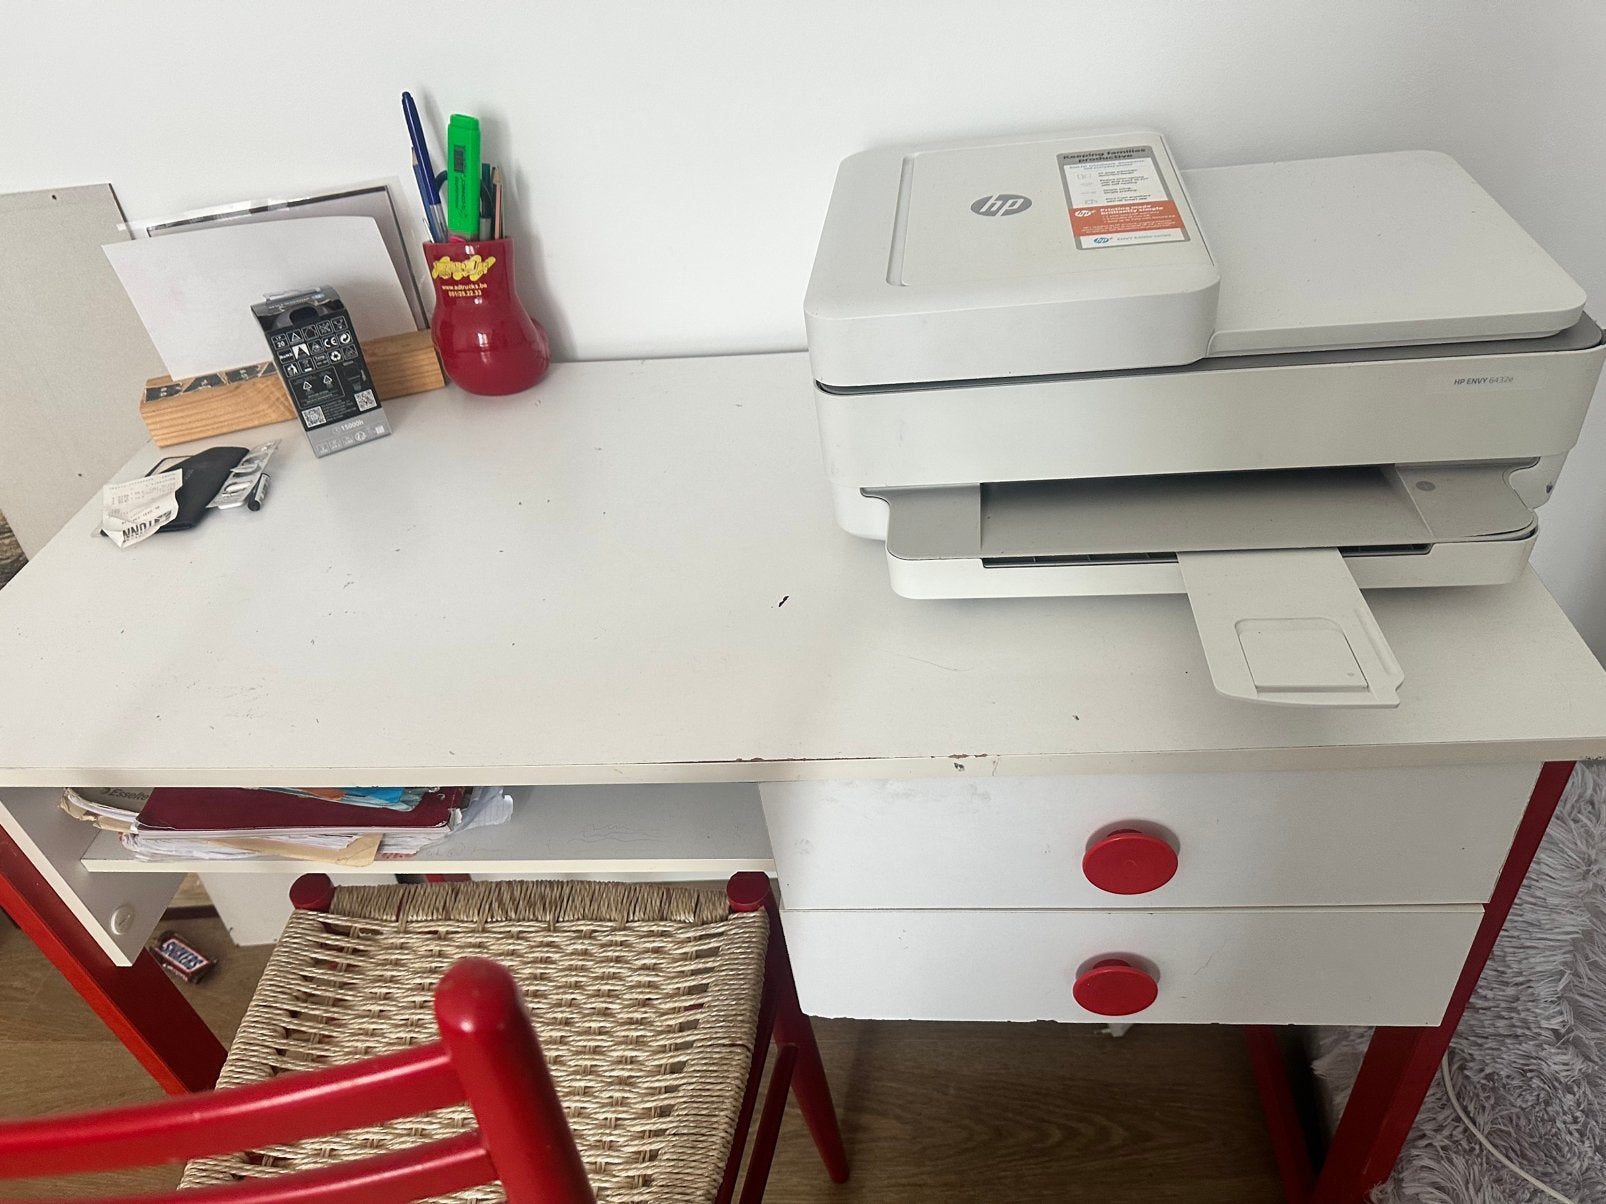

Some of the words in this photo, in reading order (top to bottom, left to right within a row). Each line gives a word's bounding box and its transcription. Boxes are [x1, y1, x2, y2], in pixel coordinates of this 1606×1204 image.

[1063, 151, 1104, 160] Keeping
[1107, 148, 1146, 156] families
[1078, 153, 1133, 163] productive
[972, 193, 1030, 217] hp
[1467, 377, 1488, 385] ENVY
